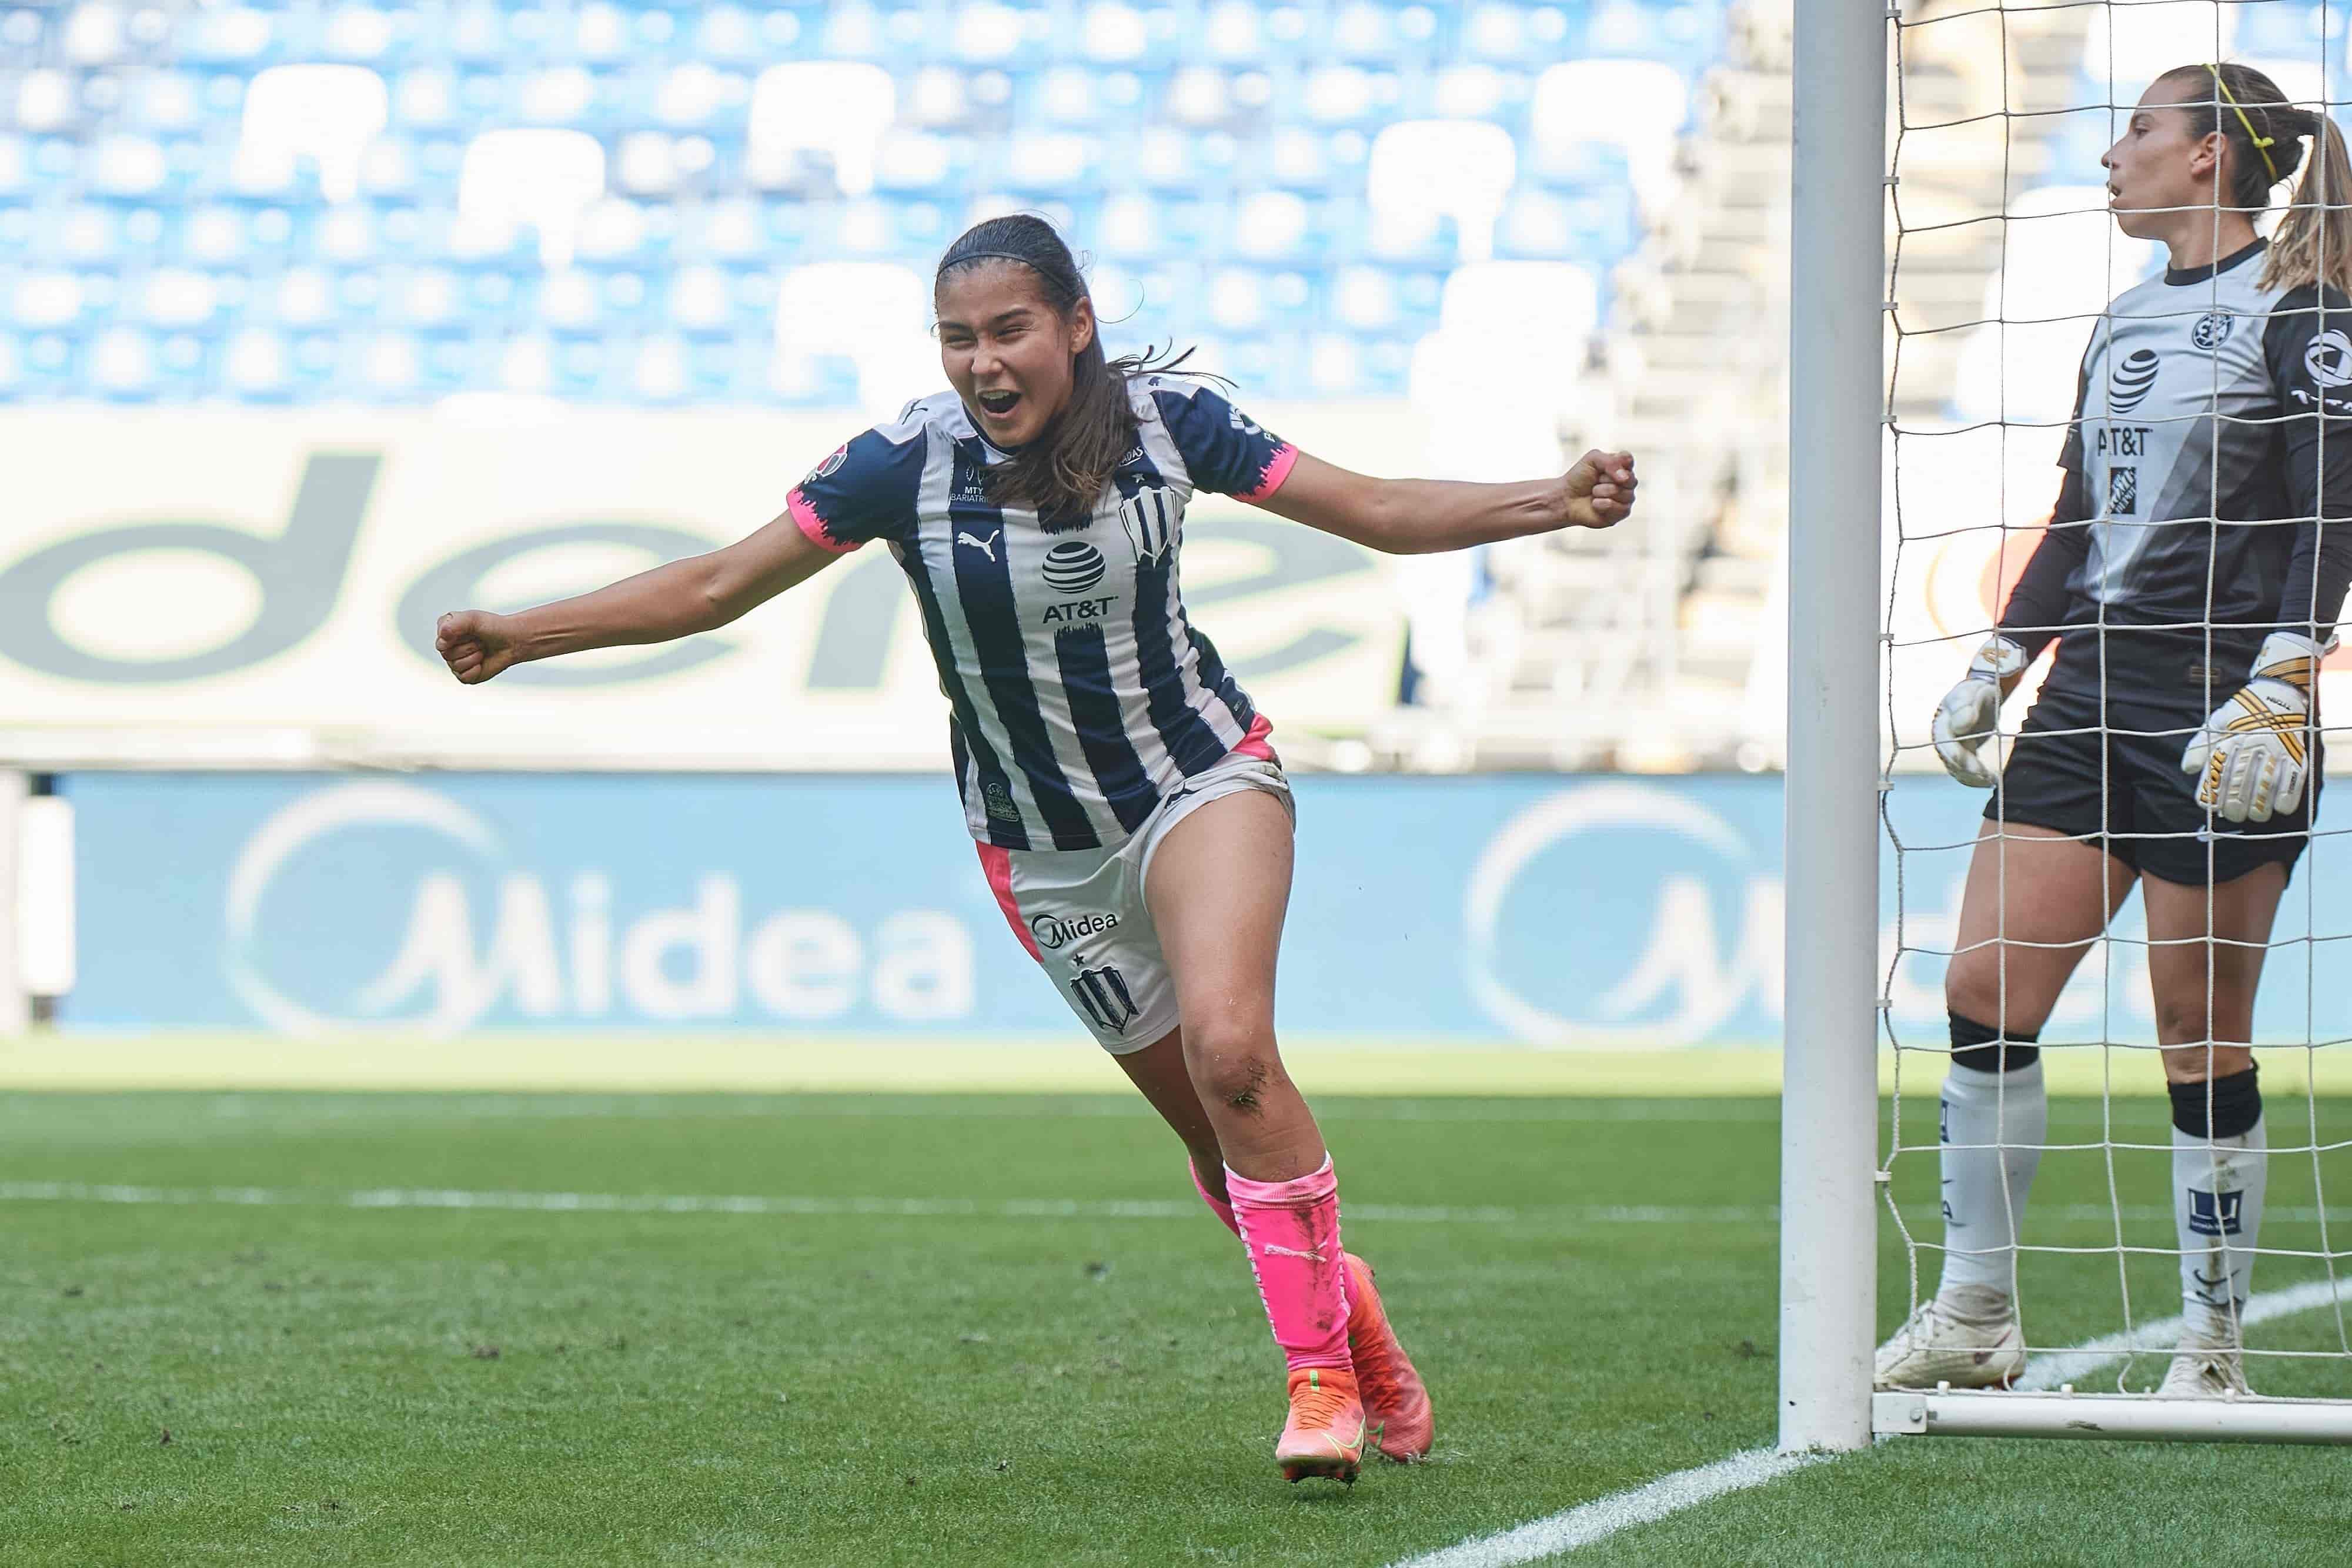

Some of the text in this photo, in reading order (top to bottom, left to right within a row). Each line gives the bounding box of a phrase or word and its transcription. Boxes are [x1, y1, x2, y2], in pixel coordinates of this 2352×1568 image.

[2097, 427, 2150, 456] AT&T
[950, 493, 988, 503] BARIATRI
[965, 486, 983, 494] MTY
[1043, 596, 1115, 624] AT&T
[226, 781, 977, 1039] Midea
[1031, 913, 1118, 950] Midea
